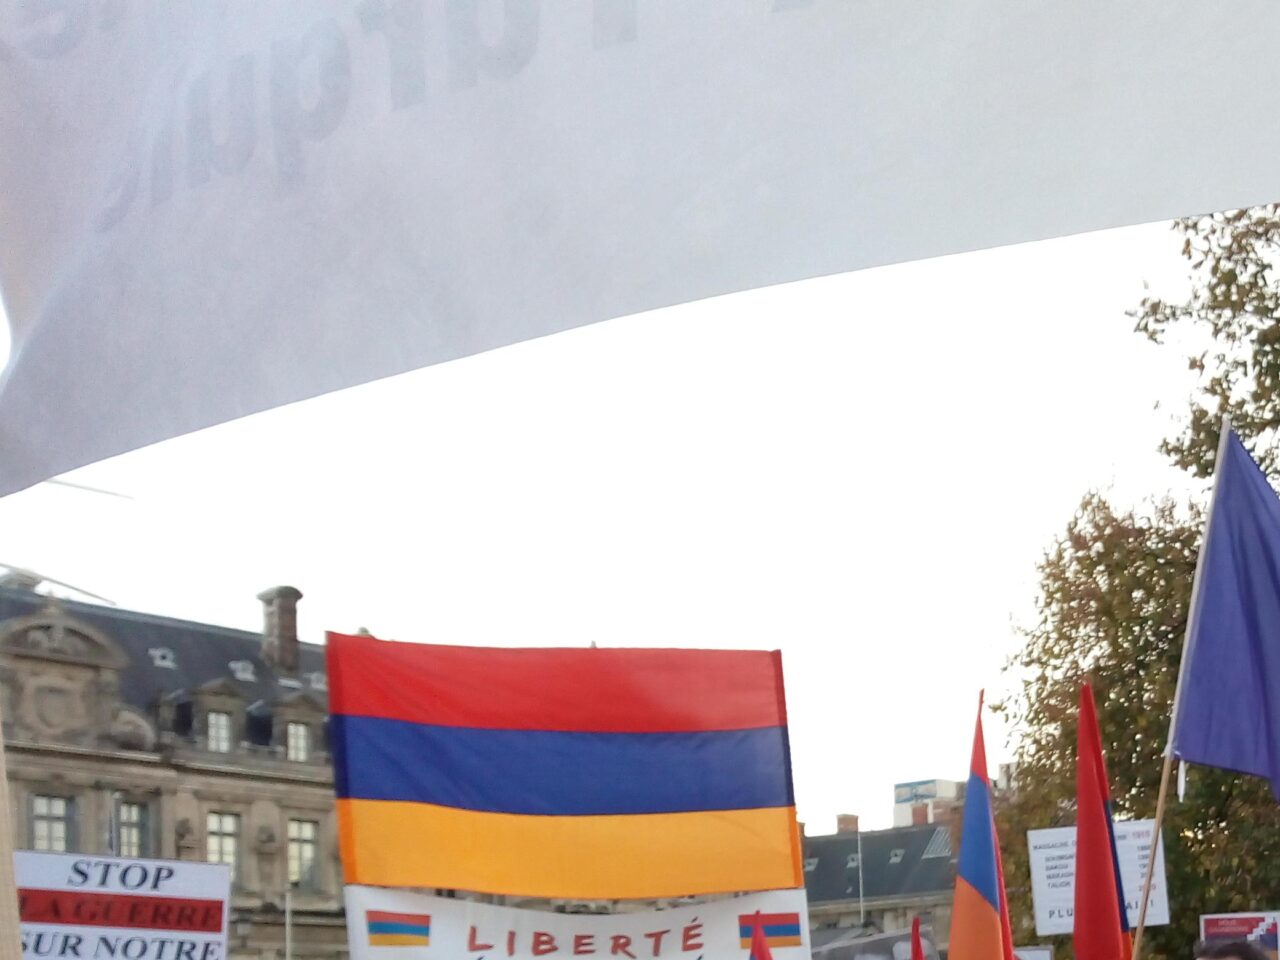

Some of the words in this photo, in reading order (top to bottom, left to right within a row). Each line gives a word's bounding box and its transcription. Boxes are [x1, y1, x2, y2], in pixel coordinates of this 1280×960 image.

[66, 859, 175, 890] STOP
[1048, 907, 1075, 919] PLU
[467, 916, 705, 959] LIBERTÉ
